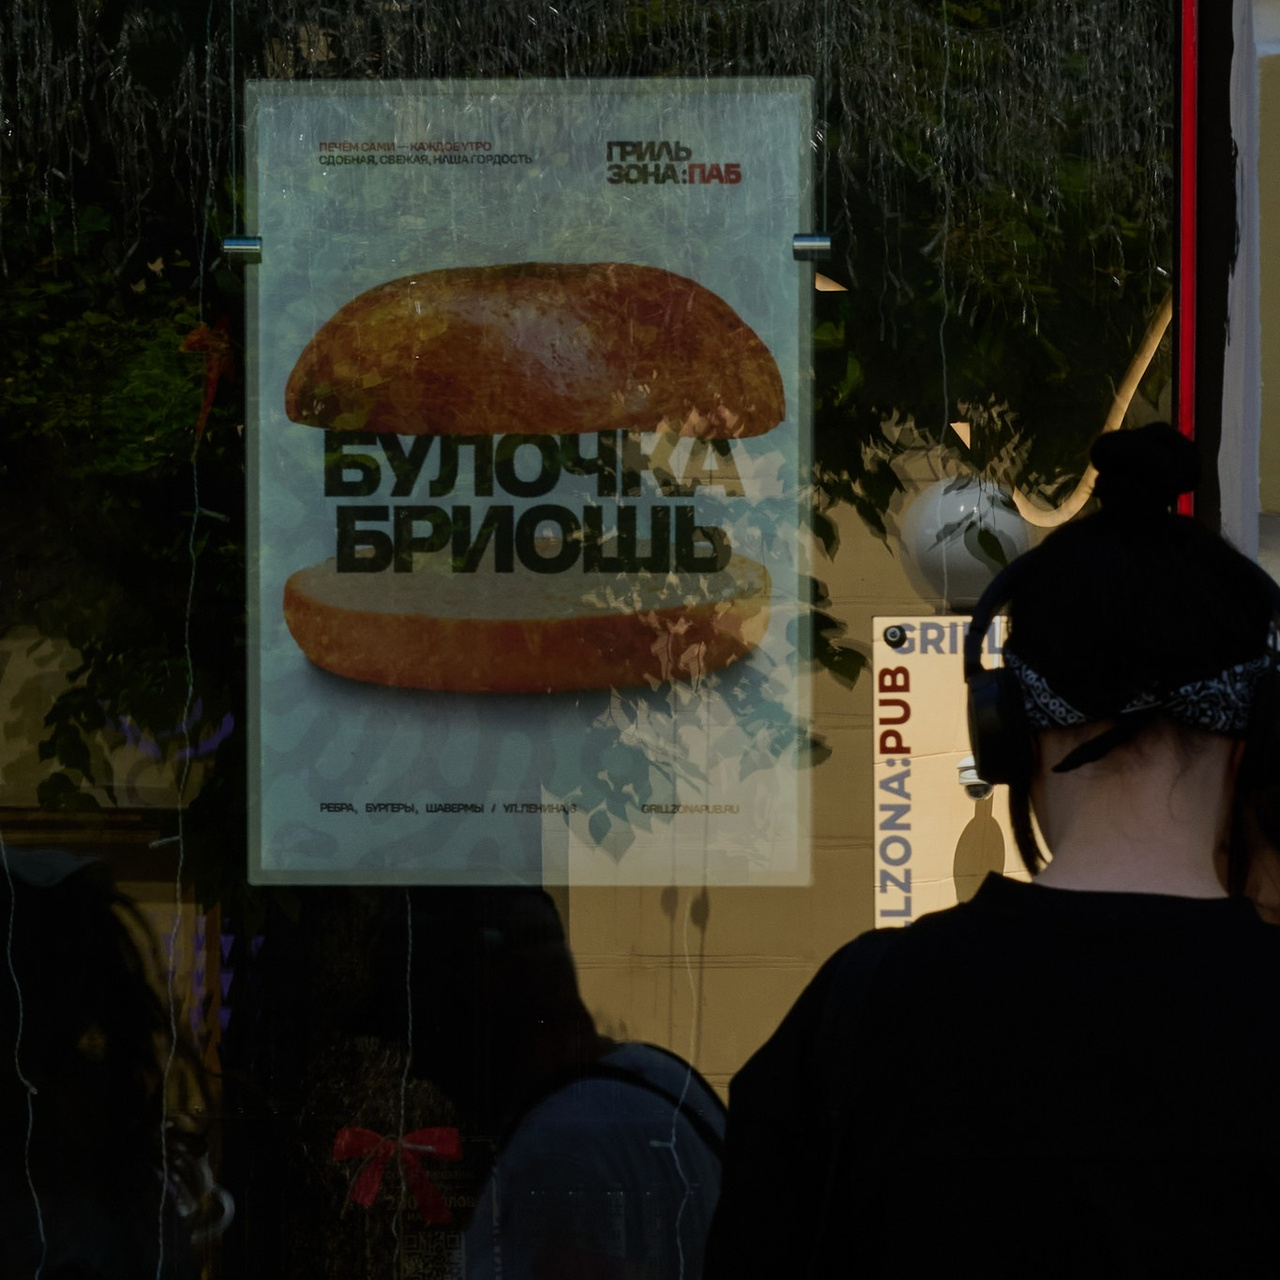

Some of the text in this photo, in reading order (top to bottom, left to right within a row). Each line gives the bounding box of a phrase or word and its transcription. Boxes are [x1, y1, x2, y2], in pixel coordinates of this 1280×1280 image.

[361, 142, 395, 152] САМИ
[606, 141, 692, 162] ГРИЛЬ
[433, 154, 469, 165] НАША
[470, 154, 533, 165] ГОРДОСТЬ
[323, 429, 746, 499] БУЛОЧКА
[335, 504, 733, 574] БРИОШЬ
[426, 802, 485, 813] ШАВЕРМЫ
